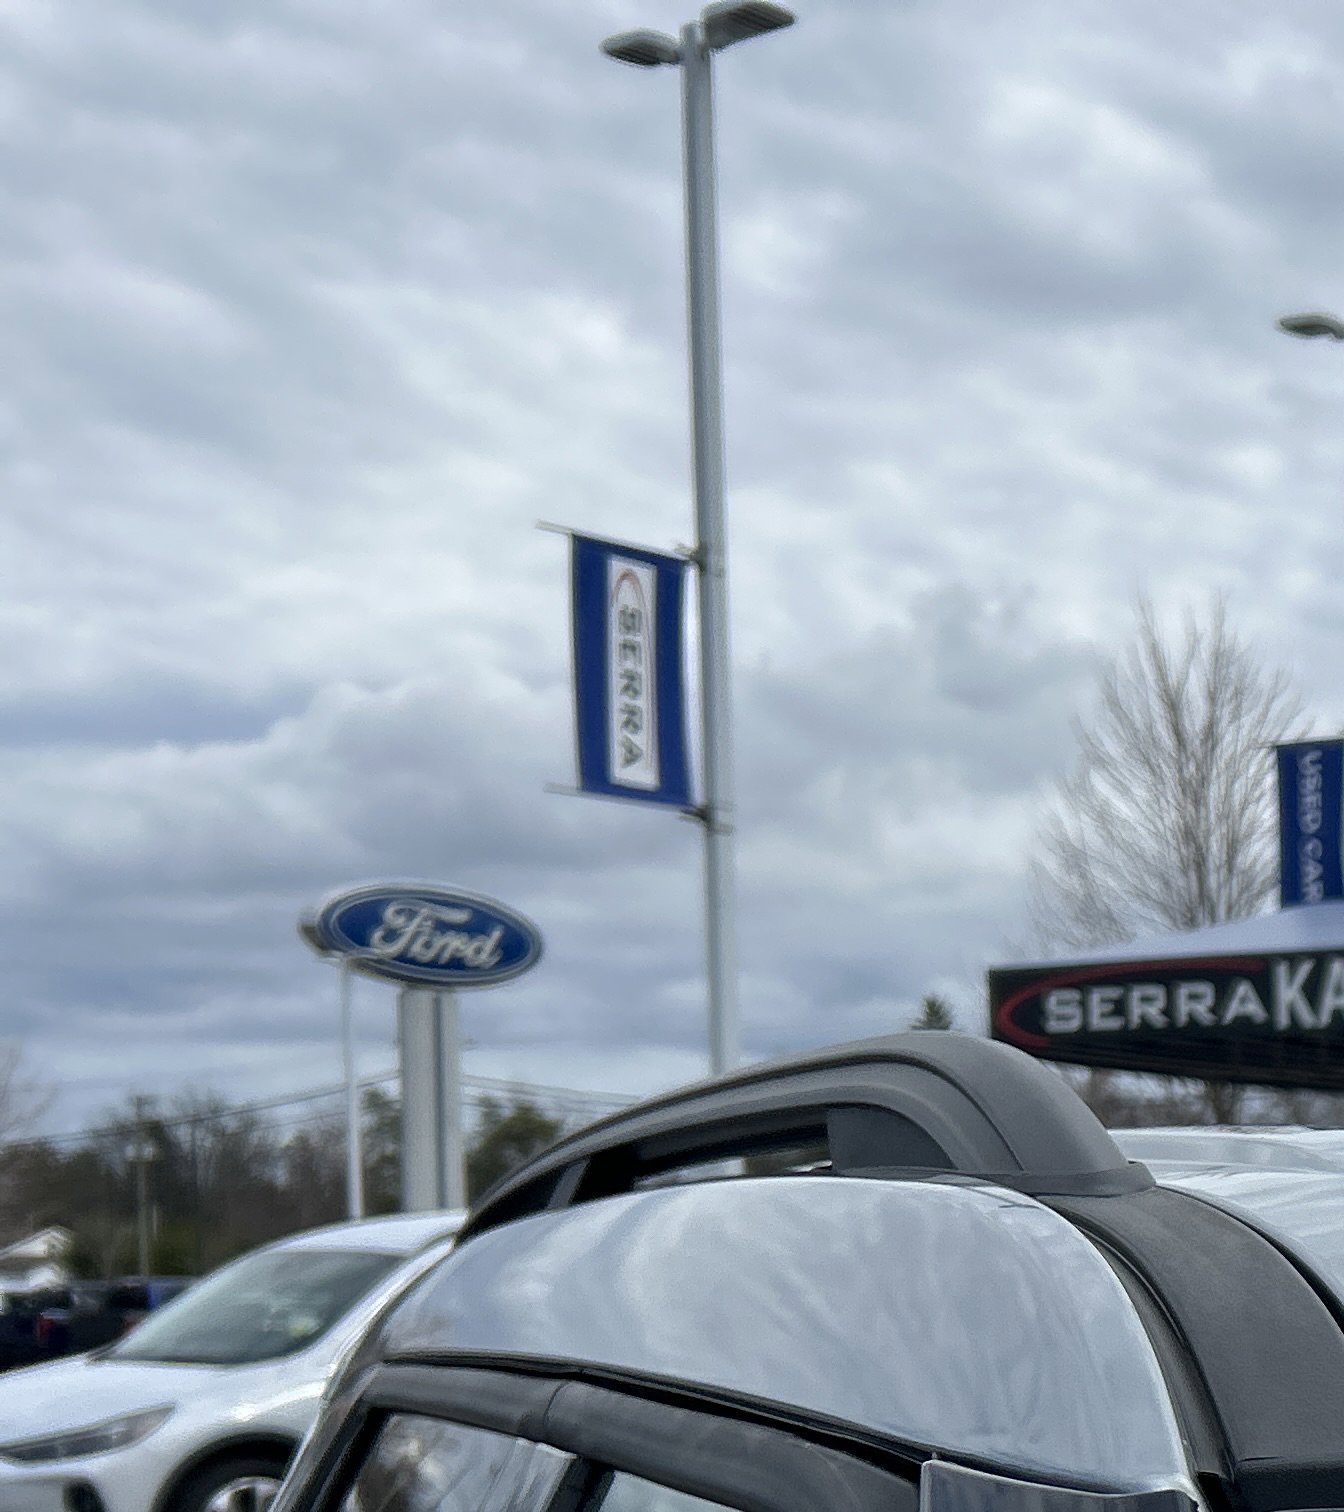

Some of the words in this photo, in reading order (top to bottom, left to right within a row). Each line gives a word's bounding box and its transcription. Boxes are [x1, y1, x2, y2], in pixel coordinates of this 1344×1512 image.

[618, 603, 643, 768] SERRA
[368, 899, 505, 969] Ford
[1041, 977, 1270, 1035] SERRA
